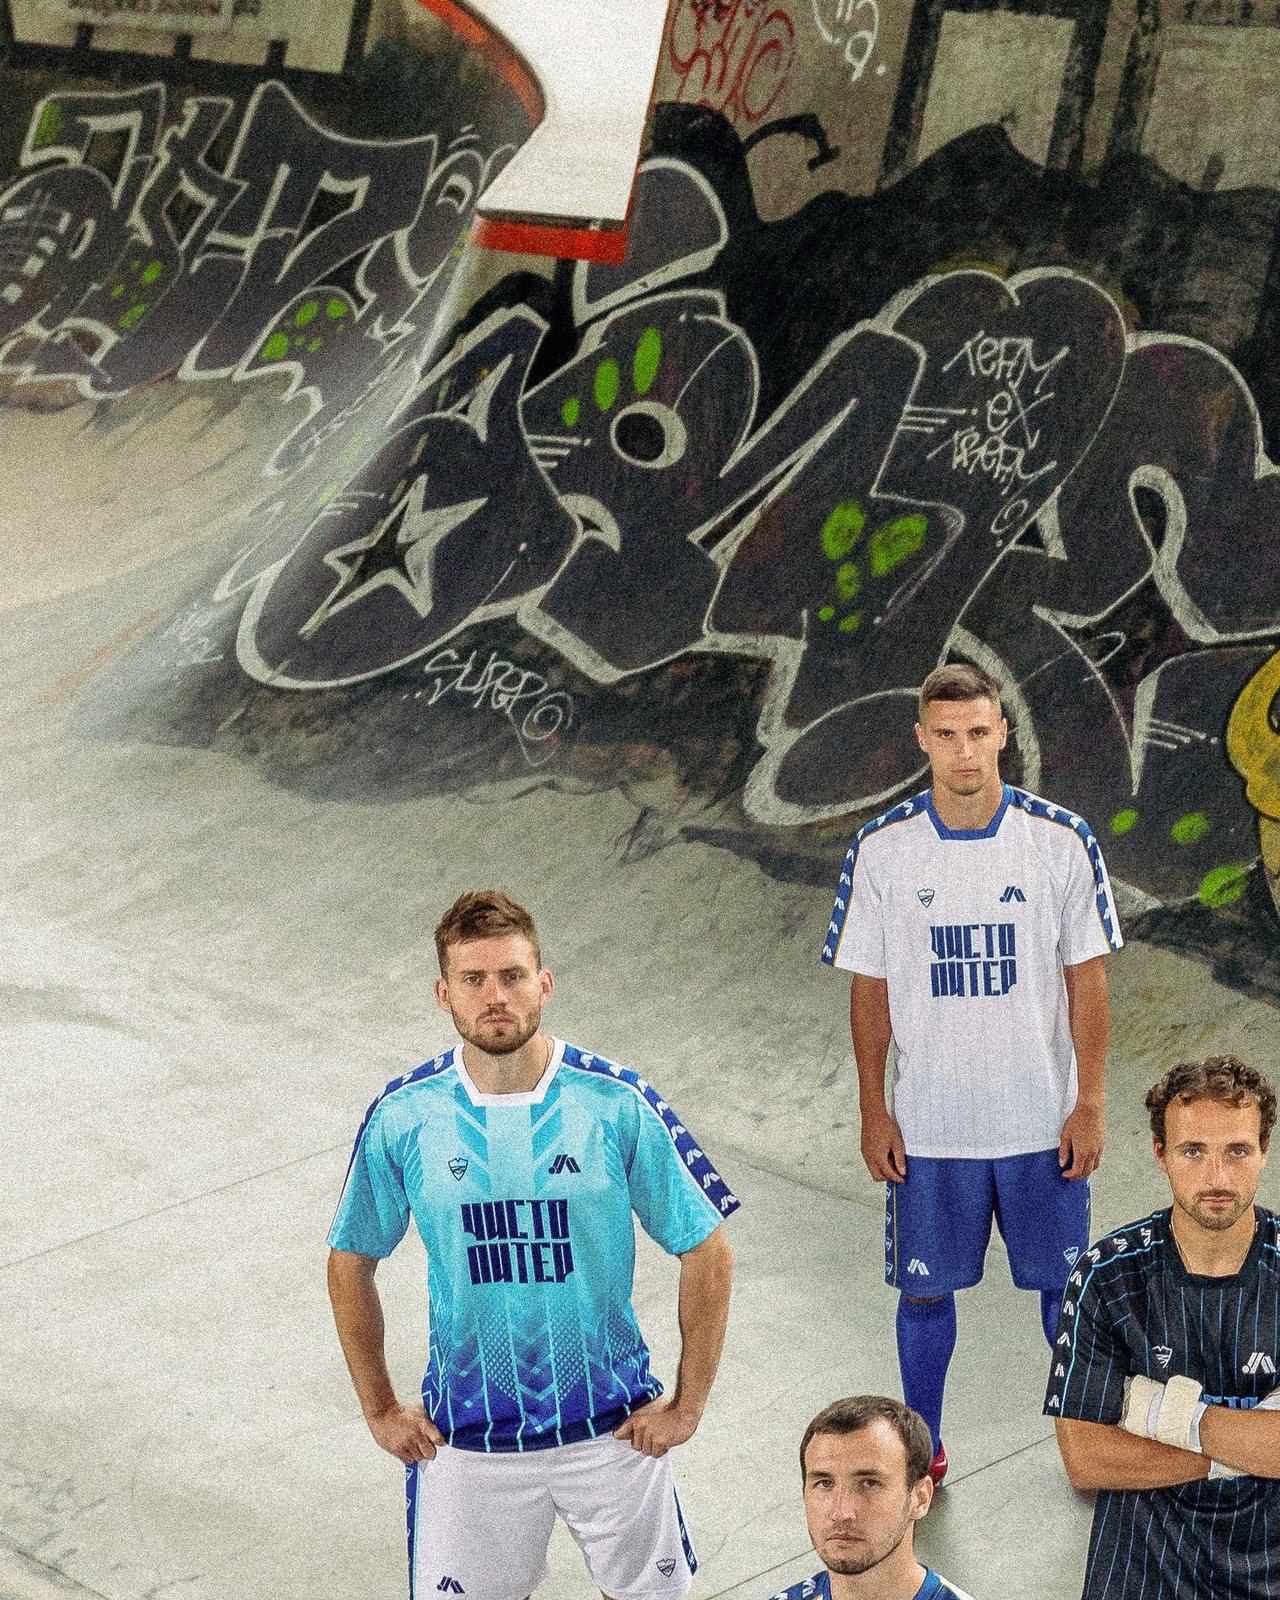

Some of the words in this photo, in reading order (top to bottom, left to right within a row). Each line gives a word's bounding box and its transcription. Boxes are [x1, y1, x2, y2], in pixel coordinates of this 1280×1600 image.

[930, 923, 1015, 960] ЧИСТО
[930, 959, 1017, 997] ПИТЕР
[460, 1199, 570, 1241] ЧИСТО
[466, 1241, 574, 1286] ПИТЕР
